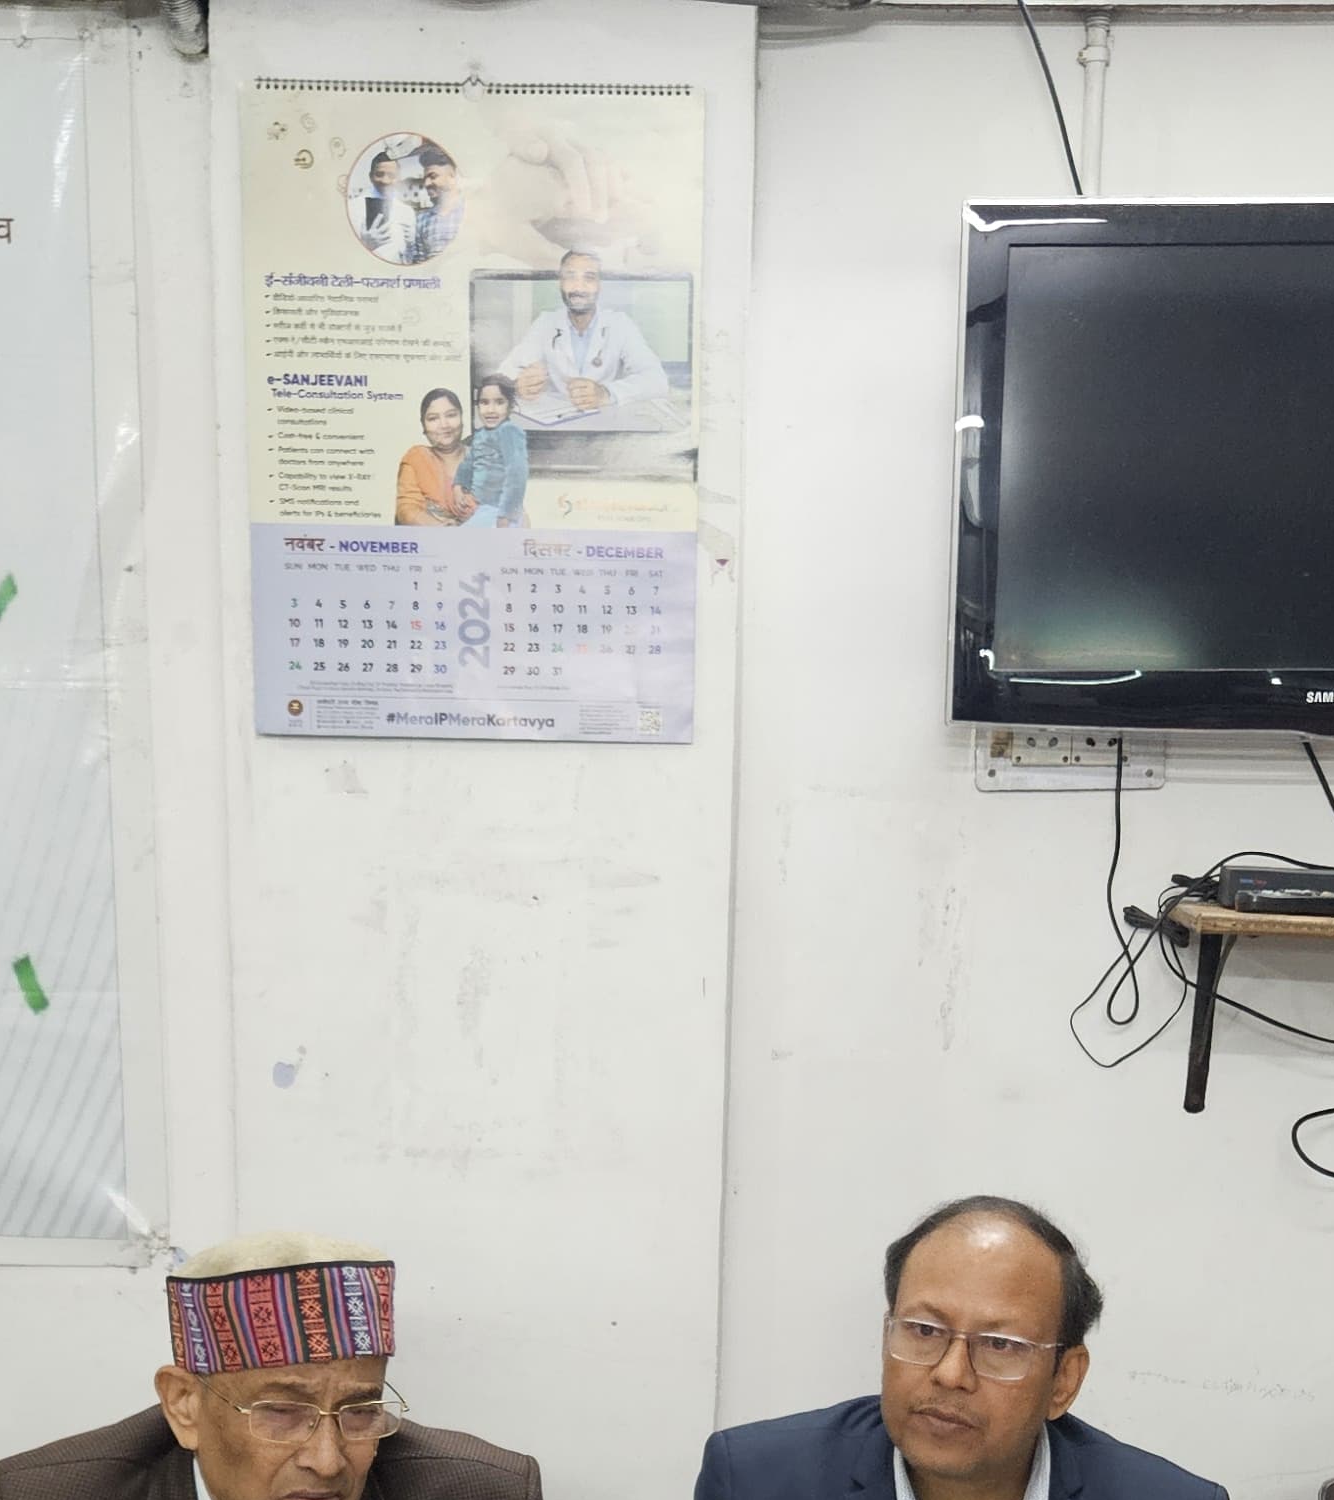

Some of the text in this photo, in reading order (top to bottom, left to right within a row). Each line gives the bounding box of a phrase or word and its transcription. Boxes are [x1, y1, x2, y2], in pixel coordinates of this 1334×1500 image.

[267, 374, 368, 387] e-SANJEEVANI
[367, 390, 404, 402] System
[283, 533, 326, 551] नवंबर
[339, 540, 419, 554] NOVEMBER
[586, 545, 665, 559] DECEMBER
[412, 581, 419, 591] 1
[506, 583, 512, 593] 1
[530, 583, 537, 593] 2
[555, 583, 562, 594] 3
[628, 586, 636, 596] 6
[315, 599, 323, 608] 4
[338, 599, 347, 609] 5
[363, 600, 371, 609] 6
[412, 600, 420, 611] 8
[436, 601, 444, 610] 9
[505, 602, 513, 613] 8
[530, 603, 538, 613] 9
[552, 603, 565, 614] 10
[578, 604, 587, 613] 11
[602, 605, 613, 615] 12
[625, 605, 638, 616] 13
[287, 617, 446, 631] 10 11 12 13 14 15 16
[458, 571, 491, 669] 2024
[504, 623, 516, 633] 15
[528, 623, 540, 633] 16
[552, 623, 563, 633] 17
[576, 623, 589, 634] 18
[289, 637, 447, 650] 17 18 19 20 21 22 23
[503, 642, 662, 655] 22 23 28
[289, 660, 448, 674] 24 25 26 27 28 29 30
[503, 665, 516, 676] 29
[526, 666, 540, 676] 30
[386, 711, 555, 730] #MeraIPMeraKartavya
